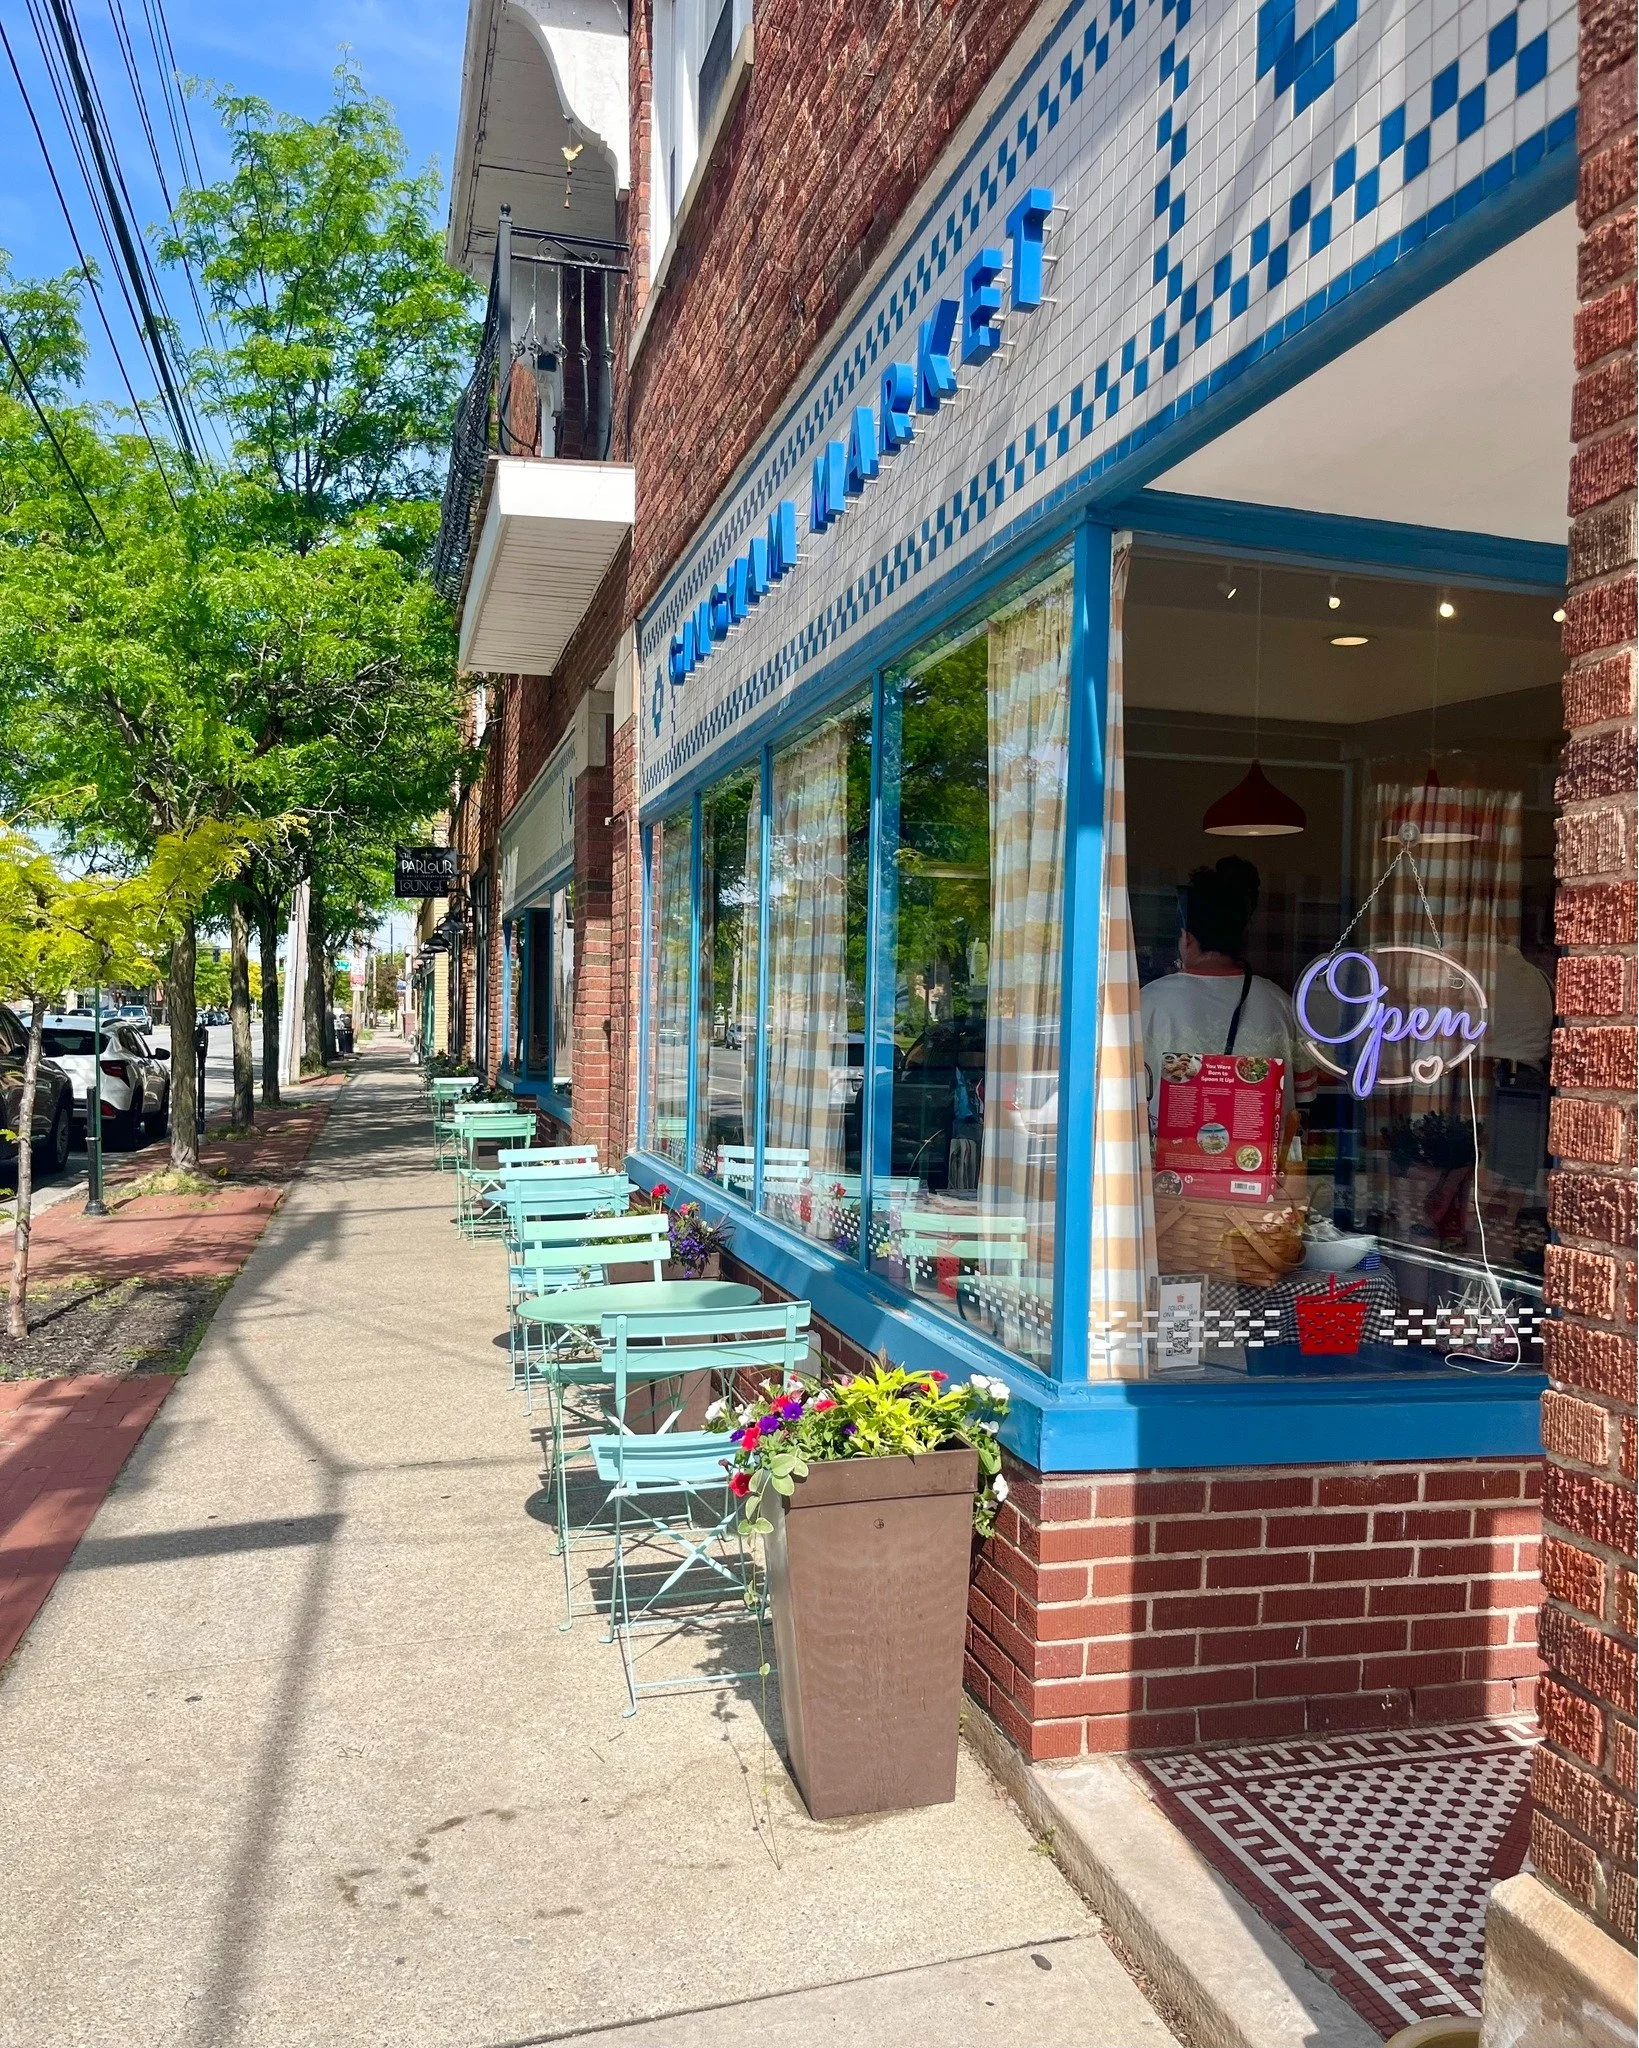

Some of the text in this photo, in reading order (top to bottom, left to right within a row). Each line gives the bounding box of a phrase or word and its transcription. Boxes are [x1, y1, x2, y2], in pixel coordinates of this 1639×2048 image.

[669, 187, 1054, 686] GINGHAM MARKET
[400, 880, 444, 892] LOUNGE
[401, 859, 453, 875] PARLOUR
[1297, 952, 1487, 1098] Open
[1271, 1114, 1281, 1178] COOKBOOK
